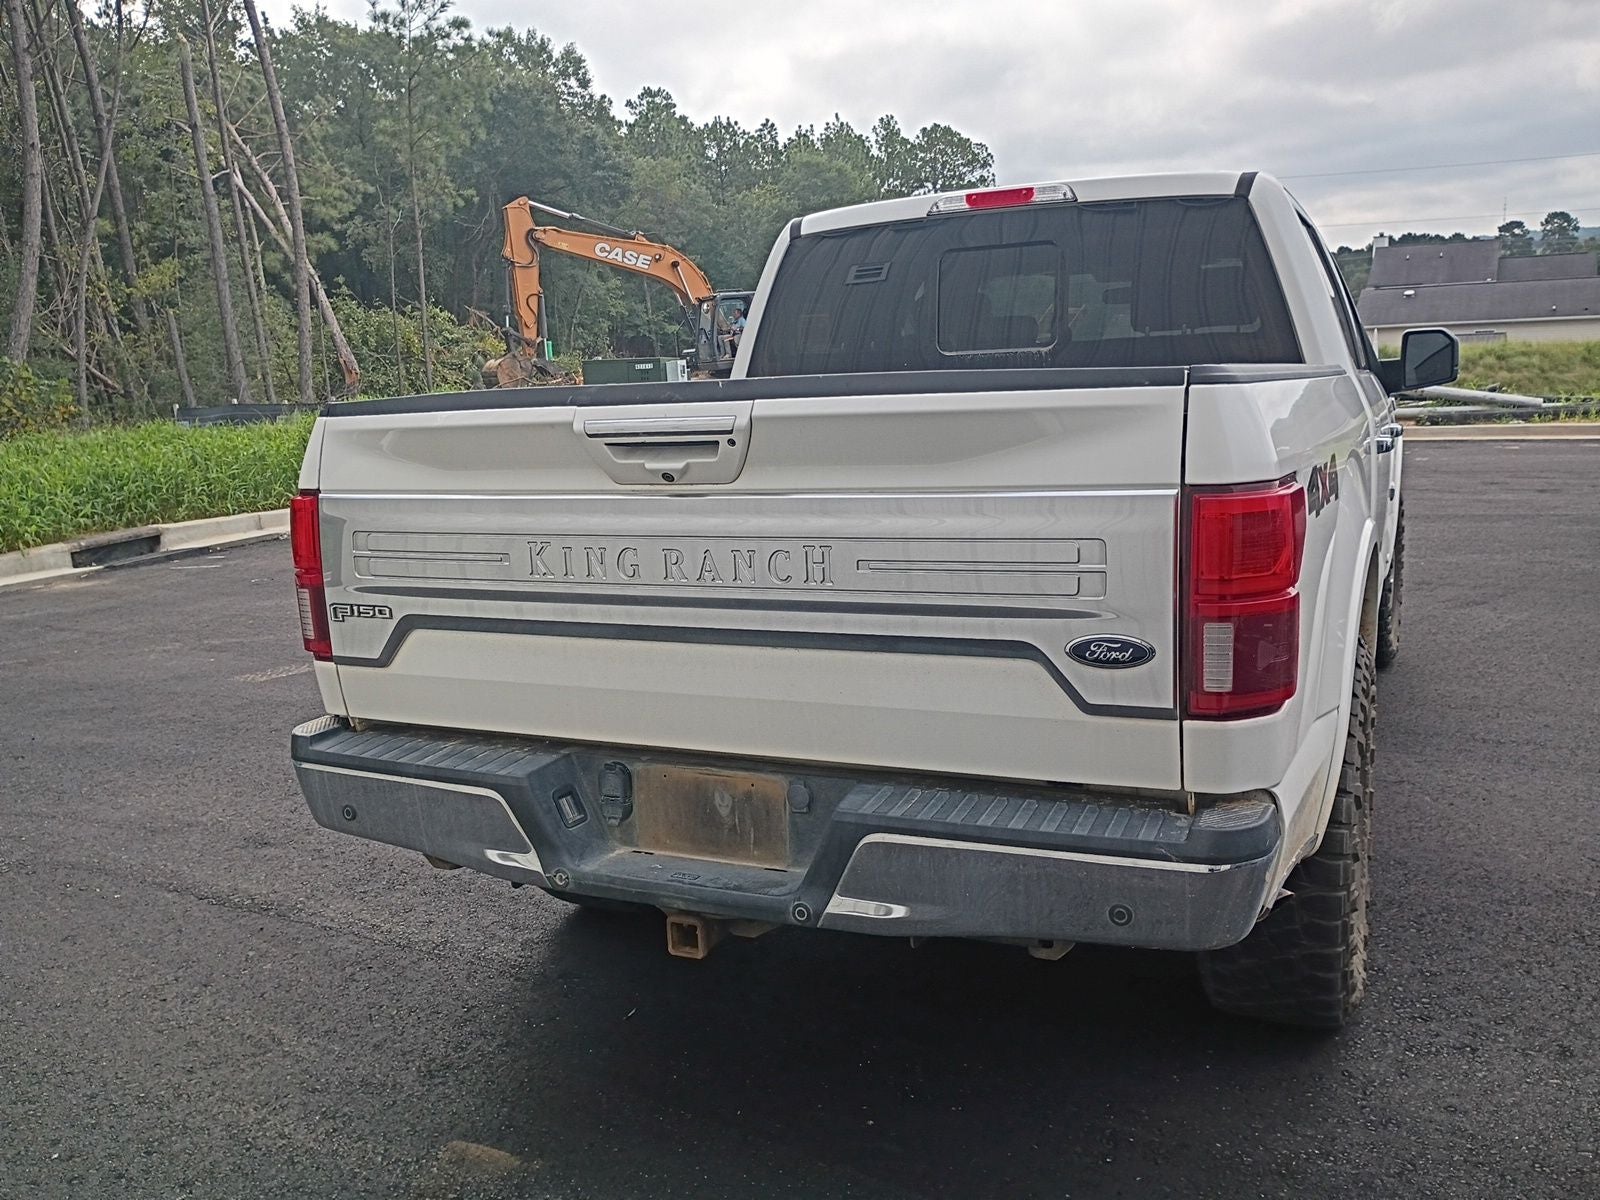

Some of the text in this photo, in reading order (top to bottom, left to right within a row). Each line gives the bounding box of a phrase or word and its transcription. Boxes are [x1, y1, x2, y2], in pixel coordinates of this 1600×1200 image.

[594, 242, 653, 270] CASE
[526, 540, 835, 586] KING RANCH
[329, 602, 393, 623] F150
[1085, 641, 1134, 661] Ford
